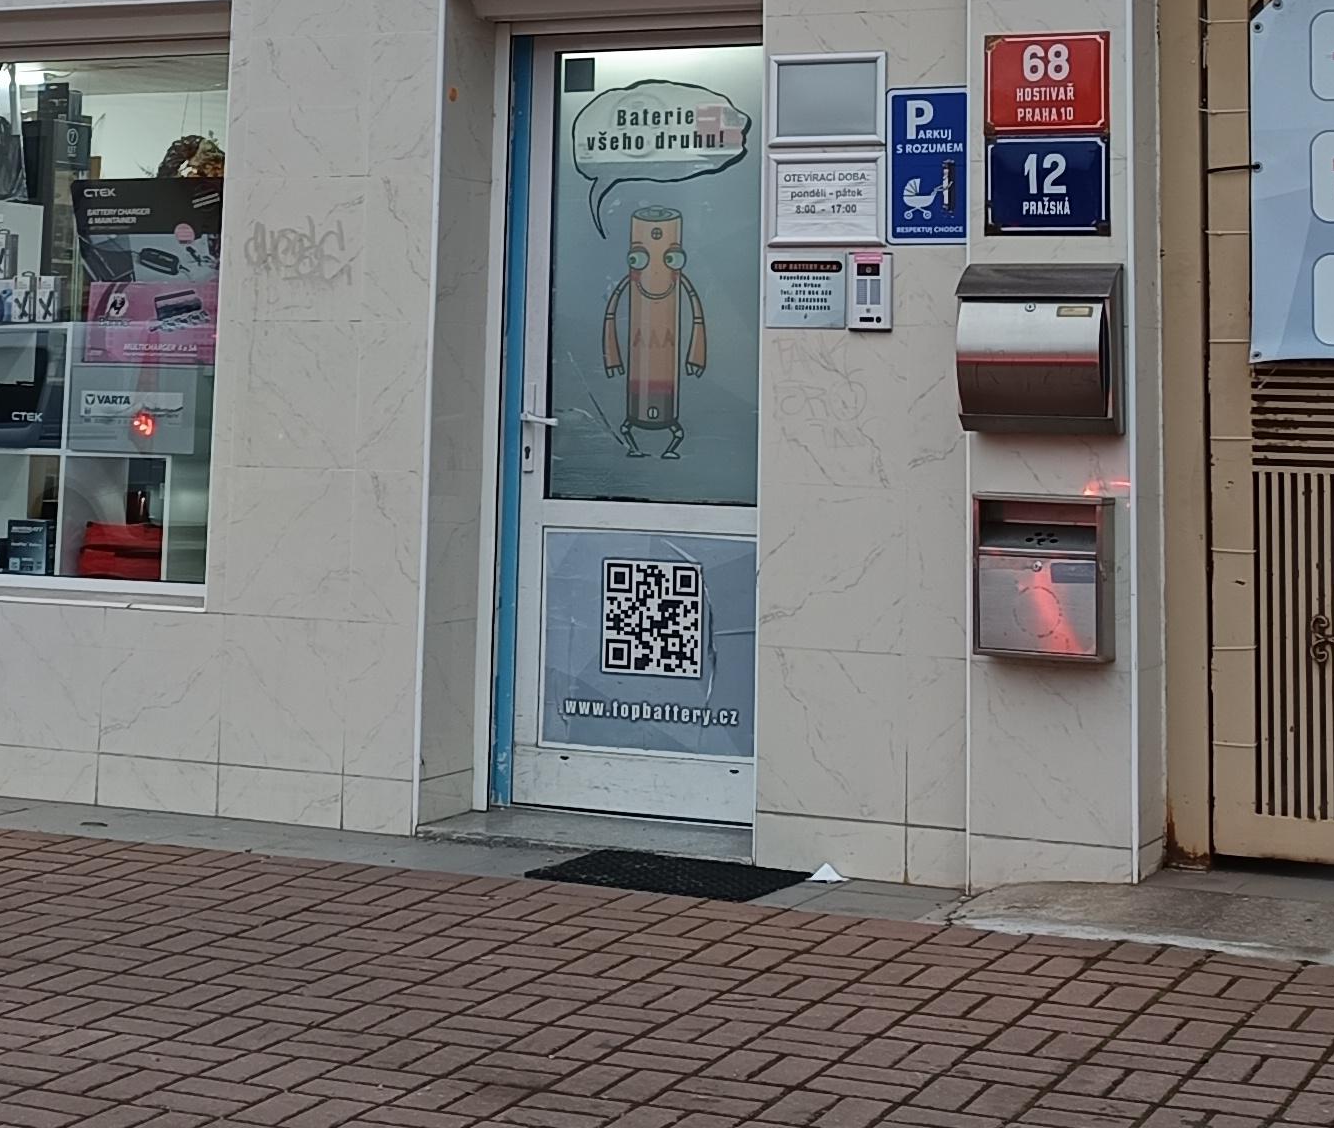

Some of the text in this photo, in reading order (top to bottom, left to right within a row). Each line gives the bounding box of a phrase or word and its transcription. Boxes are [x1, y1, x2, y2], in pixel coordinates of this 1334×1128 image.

[1023, 43, 1070, 82] 68
[1016, 82, 1075, 102] HOSTIVAŘ
[616, 107, 694, 126] Baterie
[1017, 107, 1074, 122] PRAHA 10
[586, 130, 725, 151] všeho druhu!
[896, 142, 964, 154] S ROZUMEM
[783, 172, 835, 183] OTEVÍRACÍ
[1024, 153, 1067, 194] 12
[83, 188, 116, 198] CTEK
[835, 188, 863, 199] pátek
[795, 205, 816, 214] 8:00
[831, 204, 857, 214] 17:00
[1022, 197, 1071, 215] PRAŽSKÁ
[896, 226, 932, 234] RESPEKTUJ
[97, 395, 131, 405] VARTA
[11, 411, 43, 422] CTEK
[565, 698, 740, 726] www.topbattery.cz
